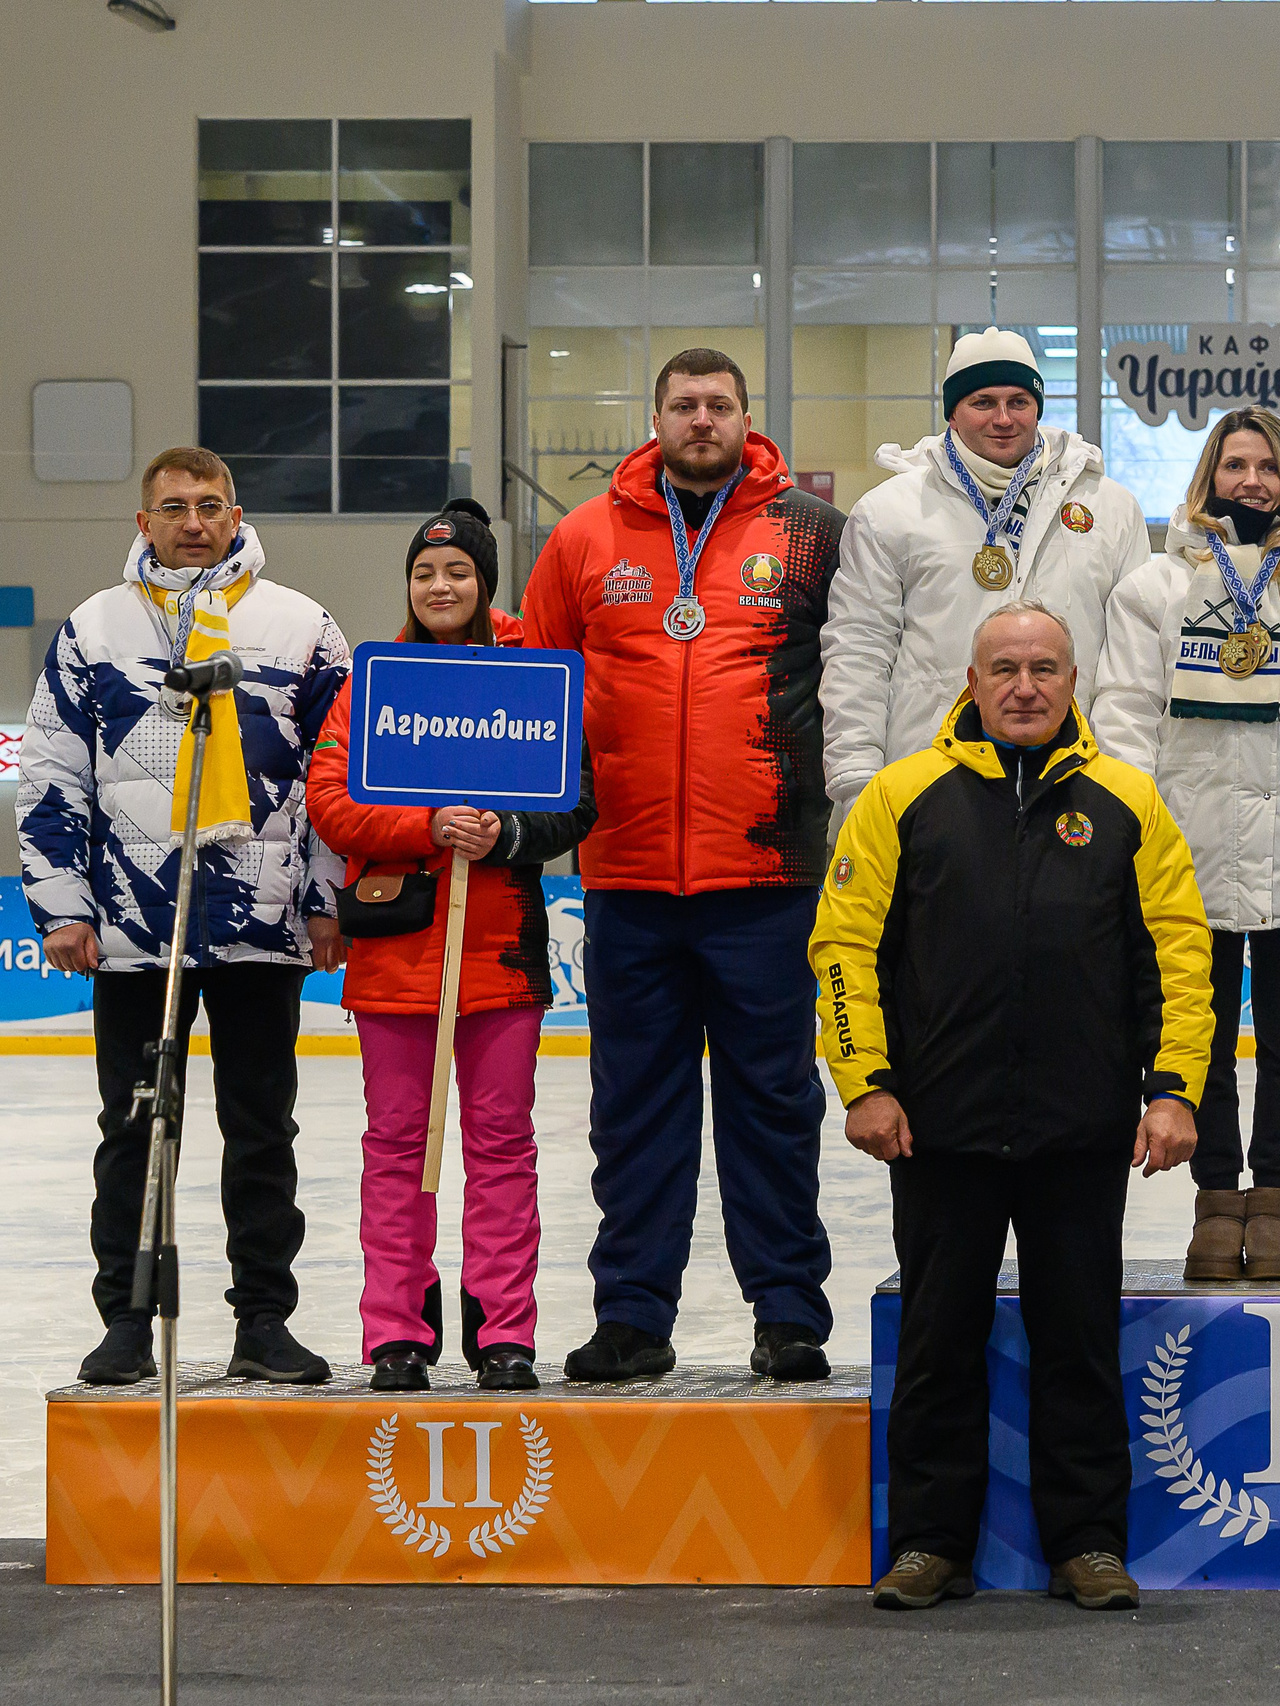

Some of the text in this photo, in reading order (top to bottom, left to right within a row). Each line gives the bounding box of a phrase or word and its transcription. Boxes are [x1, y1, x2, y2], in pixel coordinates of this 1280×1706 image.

[605, 579, 652, 592] Щедрые
[739, 595, 782, 609] BELARUS
[1180, 641, 1221, 662] БЕЛЫ
[375, 704, 557, 746] Агрохолдинг
[828, 962, 857, 1058] BELARUS
